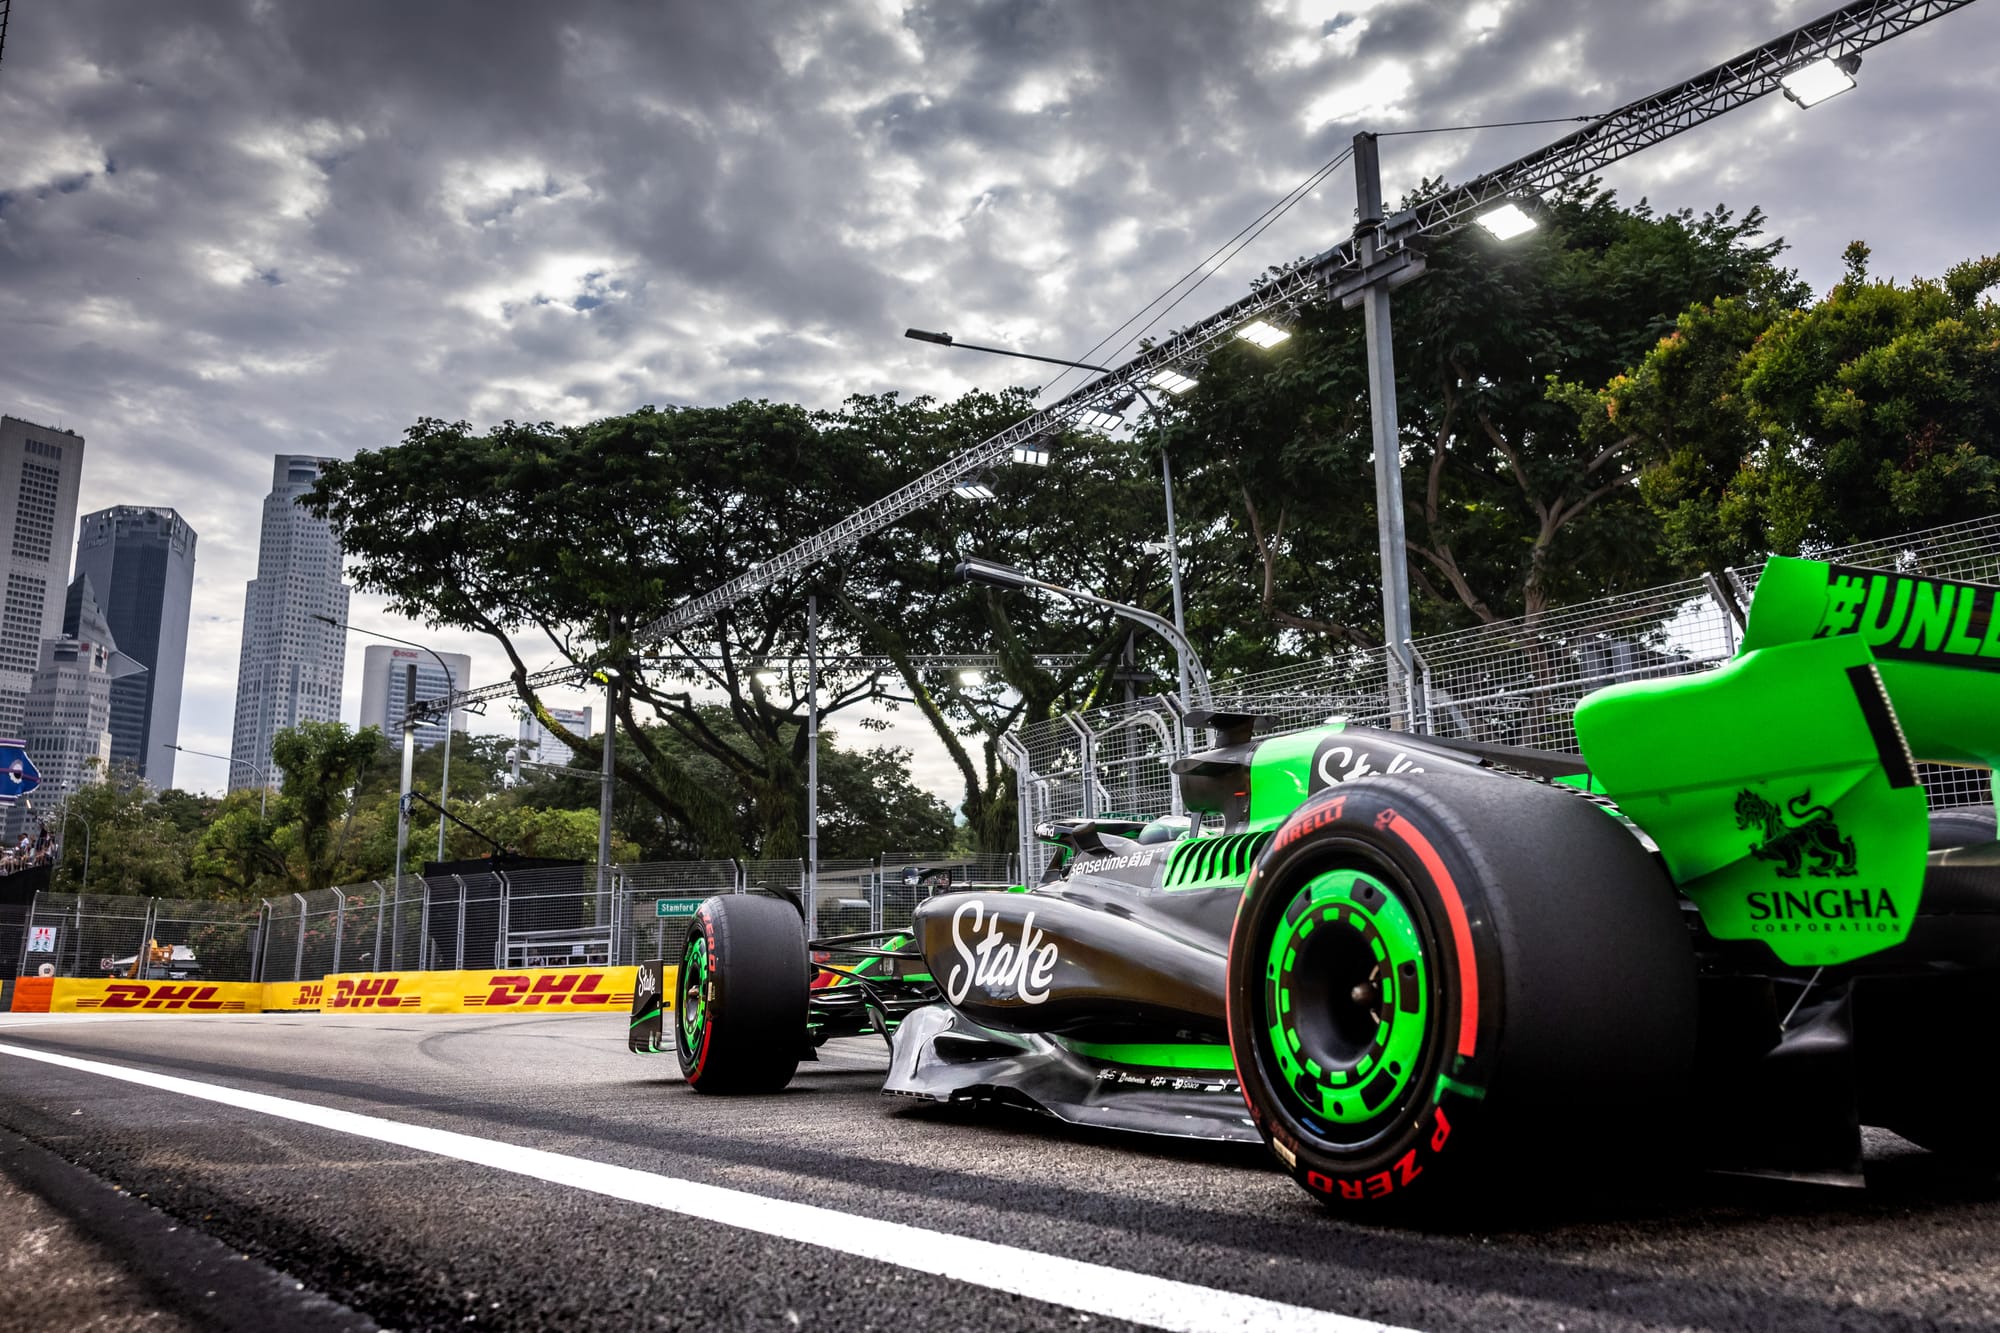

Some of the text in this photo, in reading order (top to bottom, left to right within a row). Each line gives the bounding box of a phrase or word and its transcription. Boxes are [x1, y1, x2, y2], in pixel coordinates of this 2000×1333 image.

[1273, 795, 1347, 852] PIRELLI
[1071, 855, 1129, 876] sensetime
[662, 903, 694, 912] Stamford
[1747, 888, 1898, 920] SINGHA
[1752, 923, 1900, 932] CORPORATION
[948, 900, 1058, 1005] Stake
[299, 985, 323, 1005] DH
[334, 978, 401, 1008] DHL
[485, 974, 613, 1005] DHL
[638, 964, 656, 997] Stake
[100, 984, 218, 1009] DHL
[1431, 1106, 1451, 1152] P
[1307, 1149, 1422, 1199] ZERO
